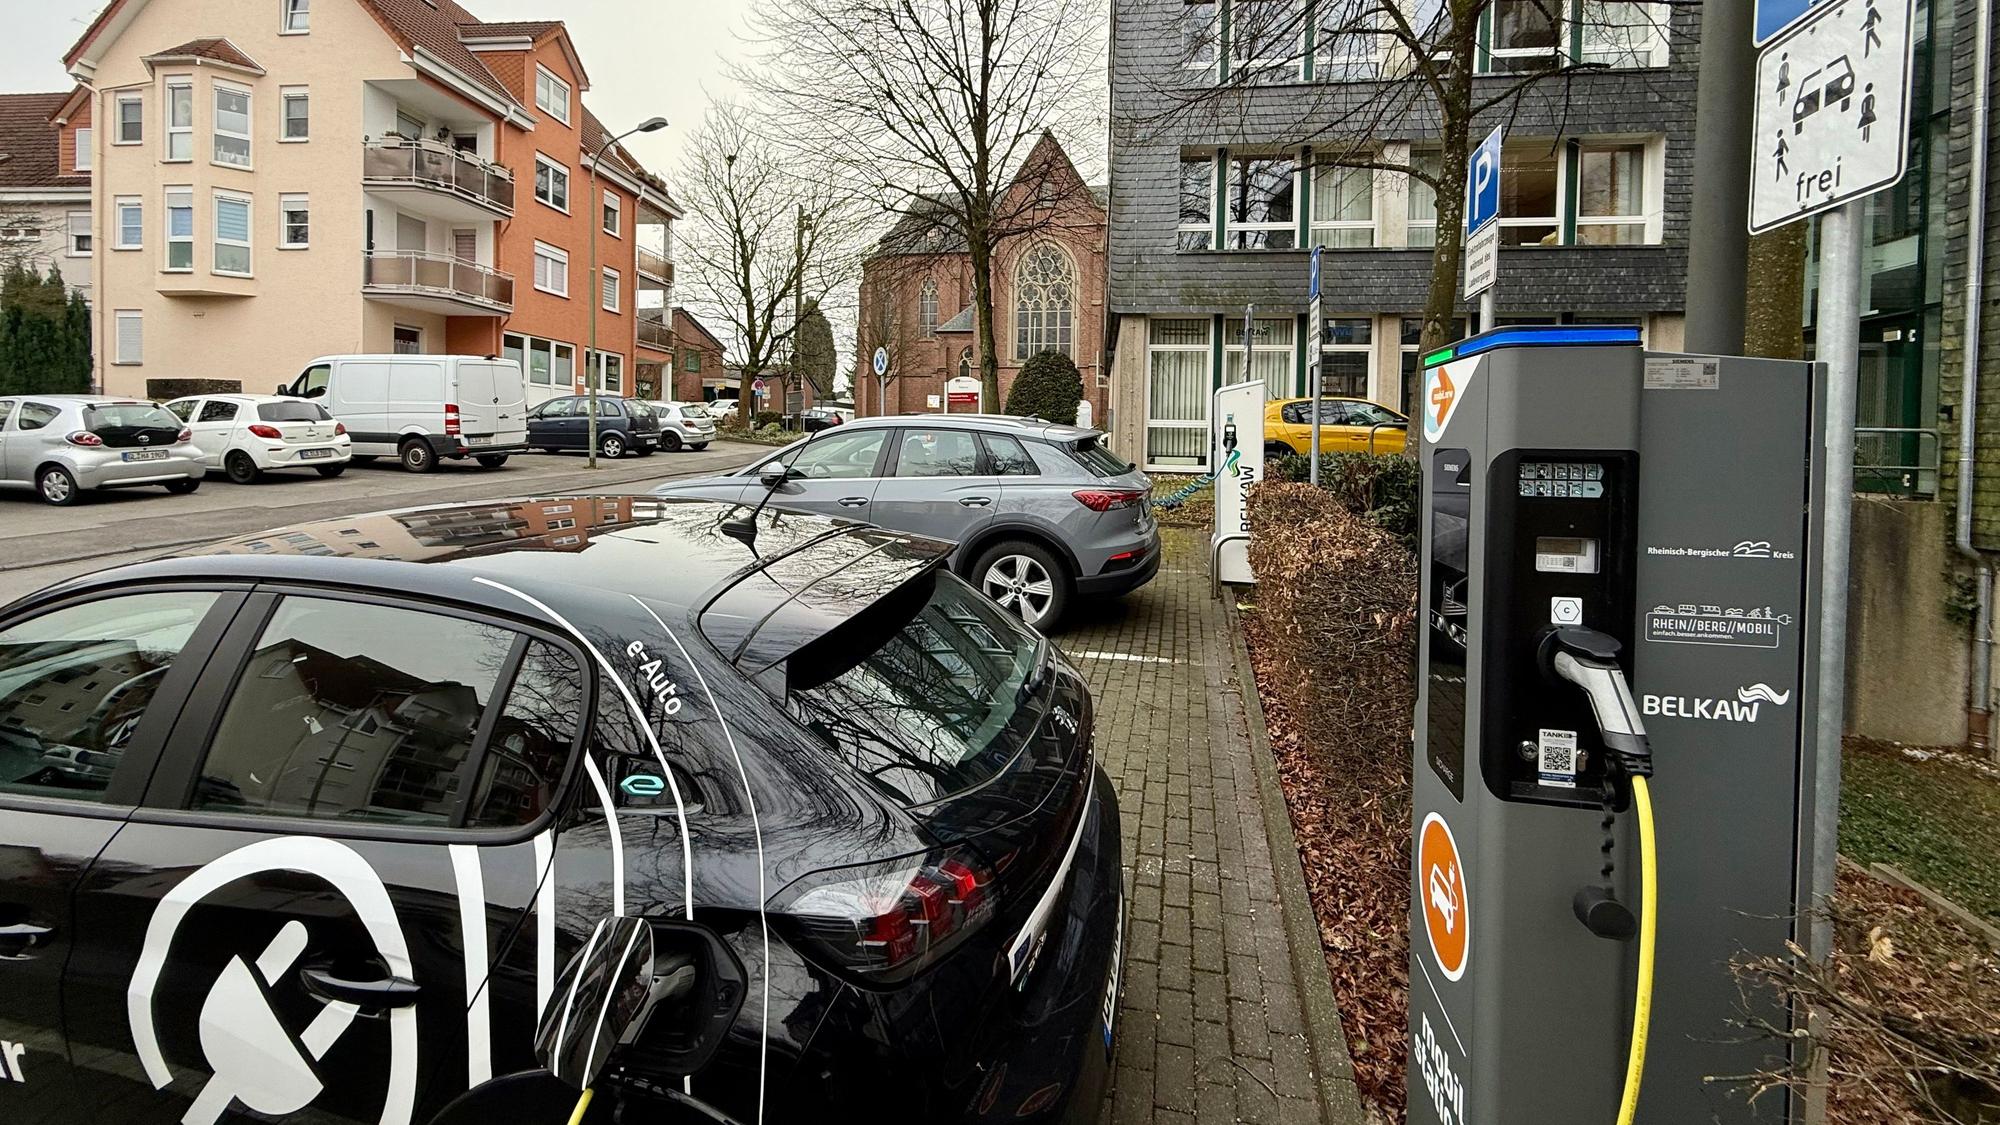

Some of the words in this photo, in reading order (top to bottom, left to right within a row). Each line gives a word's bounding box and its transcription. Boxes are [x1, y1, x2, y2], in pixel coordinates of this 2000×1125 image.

[1474, 151, 1492, 221] P
[1797, 156, 1841, 202] frei
[1647, 547, 1730, 558] Rheinisch-Bergischer
[1773, 551, 1794, 559] Kreis
[1563, 606, 1570, 614] C
[626, 640, 682, 715] e-Auto
[1642, 694, 1759, 723] BELKAW
[1422, 1011, 1464, 1125] mobil
